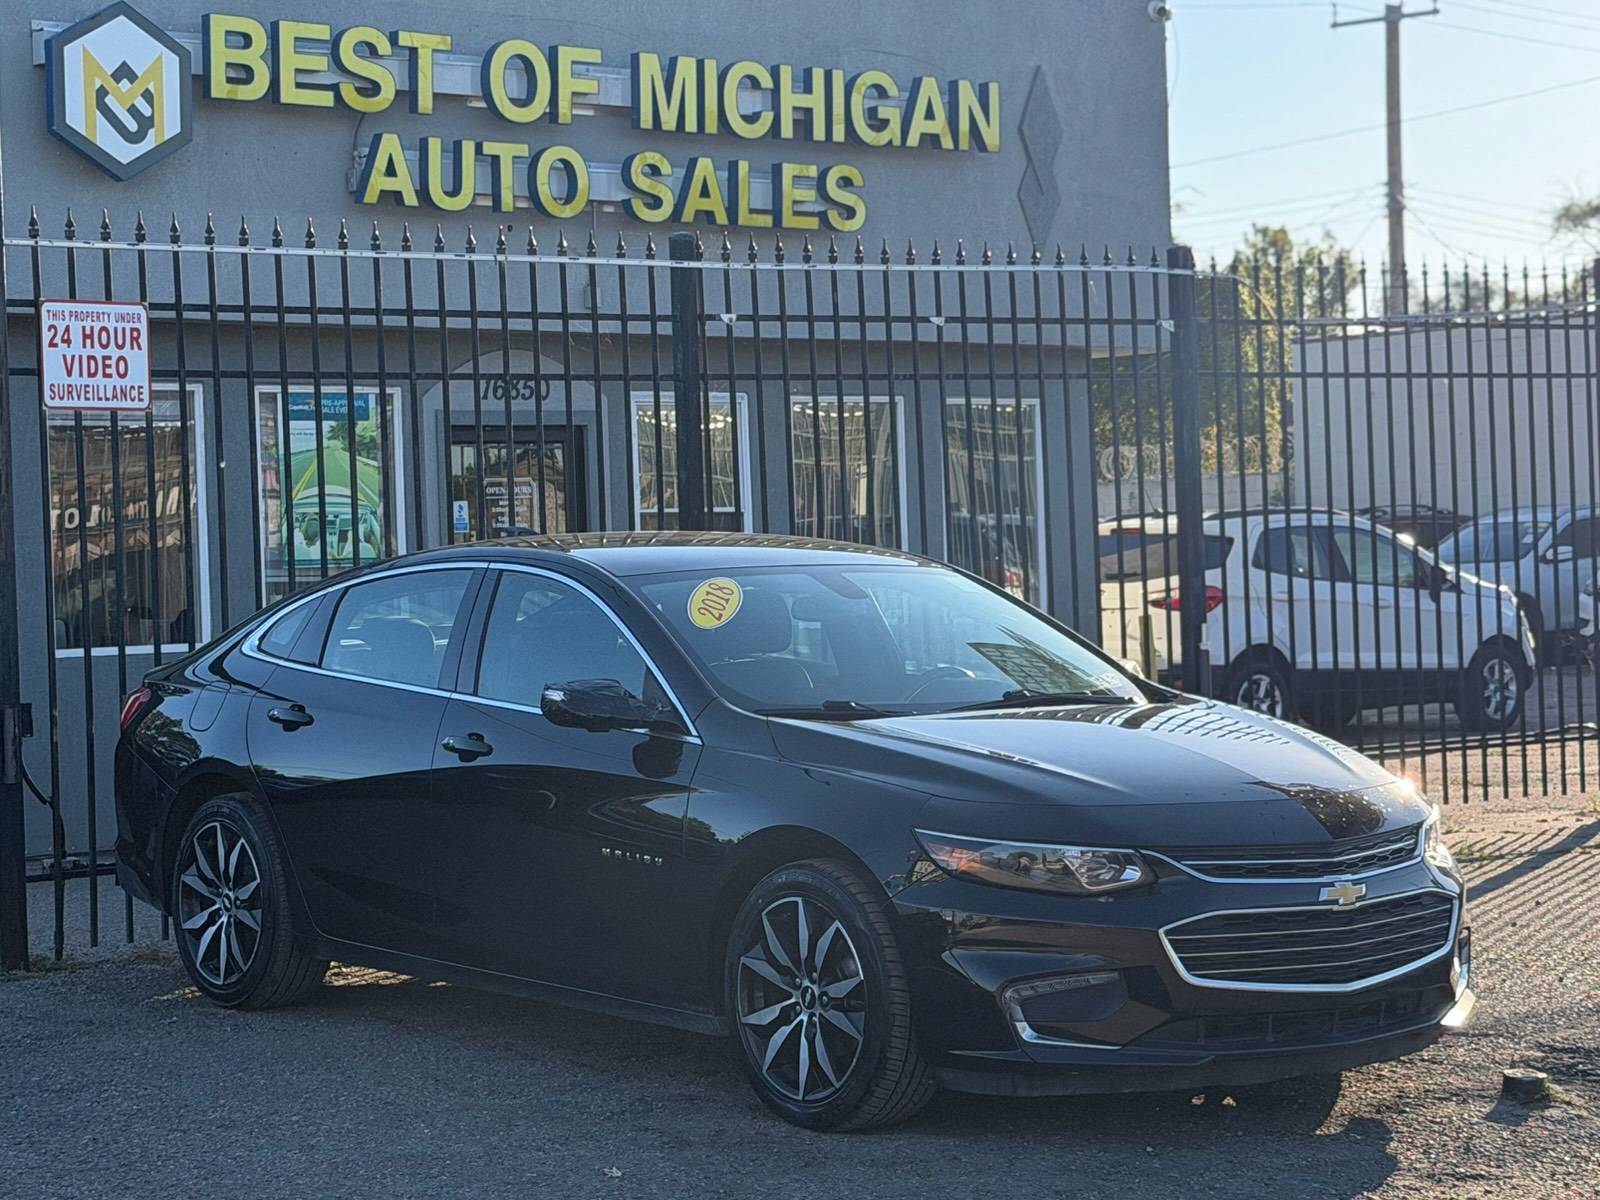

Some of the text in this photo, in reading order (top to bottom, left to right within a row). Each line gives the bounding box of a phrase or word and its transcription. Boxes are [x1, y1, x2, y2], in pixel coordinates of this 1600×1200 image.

[205, 12, 1001, 153] BEST OF MICHIGAN
[359, 131, 866, 233] AUTO SALES
[46, 310, 142, 324] THIS PROPERTY UNDER
[47, 324, 142, 350] 24 HOUR
[62, 353, 129, 379] VIDEO
[49, 383, 144, 402] SURVEILLANCE
[697, 583, 735, 621] 2018
[601, 848, 663, 866] MALIBU
